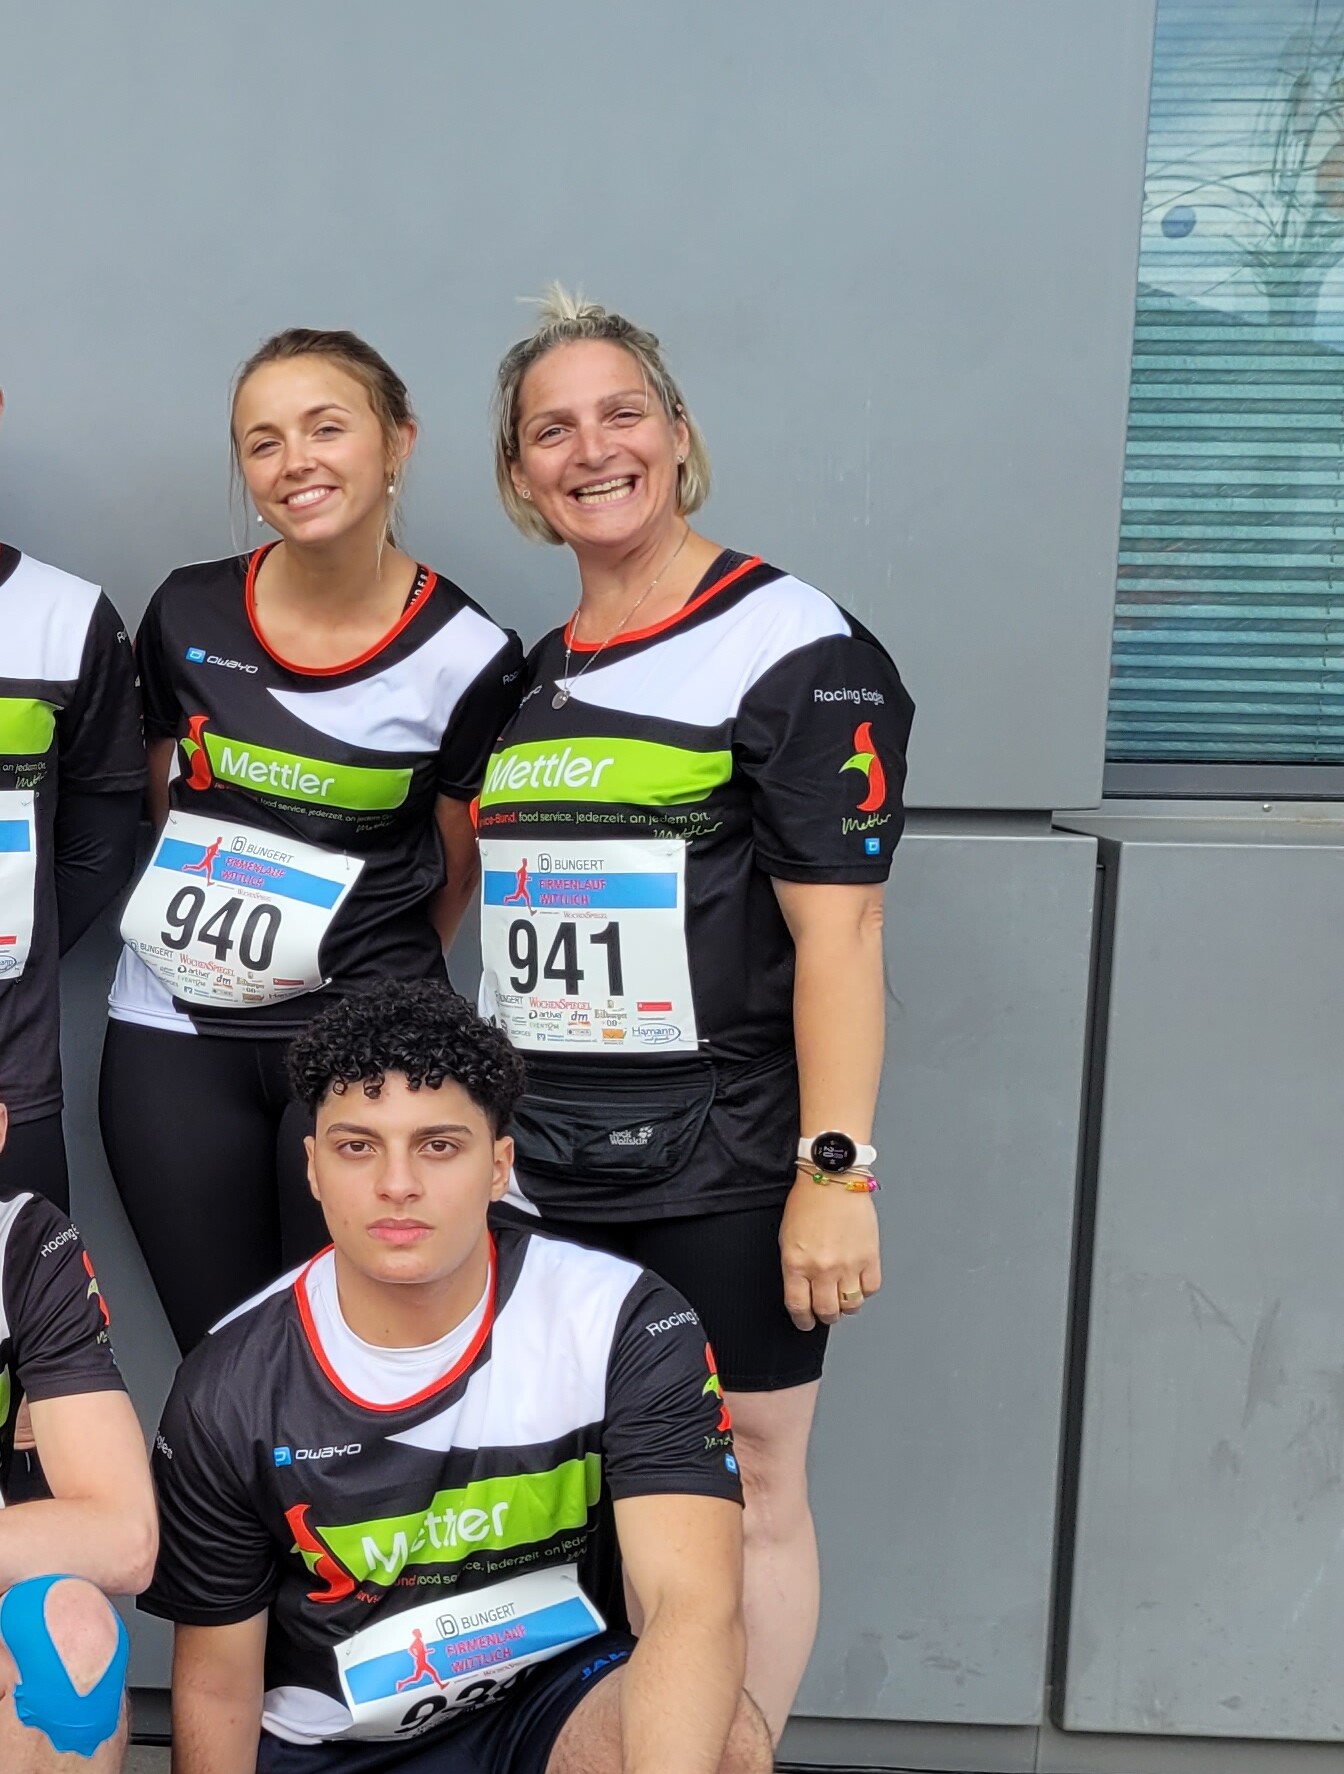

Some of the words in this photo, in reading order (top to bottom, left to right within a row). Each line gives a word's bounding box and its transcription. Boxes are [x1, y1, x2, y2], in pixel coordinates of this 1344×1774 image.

[206, 655, 258, 674] owayo
[814, 688, 860, 705] Racing
[2, 764, 13, 772] an
[220, 746, 335, 797] Mettler
[484, 747, 615, 795] Mettler
[518, 811, 539, 822] food
[539, 812, 574, 822] service.
[575, 811, 627, 824] jederzeit.
[630, 815, 646, 823] an
[690, 812, 711, 823] Ort.
[246, 844, 294, 864] BUNGERT
[225, 857, 286, 878] FIRMENLAUF
[555, 860, 604, 870] BUNGERT
[222, 870, 264, 887] WITTLICH
[540, 879, 606, 890] FIRMENLAUF
[540, 894, 589, 905] WITTLICH
[161, 885, 282, 971] 940
[140, 943, 173, 959] BUNGERT
[508, 918, 624, 996] 941
[571, 1012, 588, 1021] dm
[632, 1027, 674, 1037] Hamann
[646, 1308, 698, 1337] Racing
[295, 1443, 362, 1460] owayo
[544, 1546, 561, 1557] an
[461, 1602, 515, 1629] BUNGERT
[447, 1624, 525, 1657] FIRMENLAUF
[452, 1648, 511, 1672] WITTLICH
